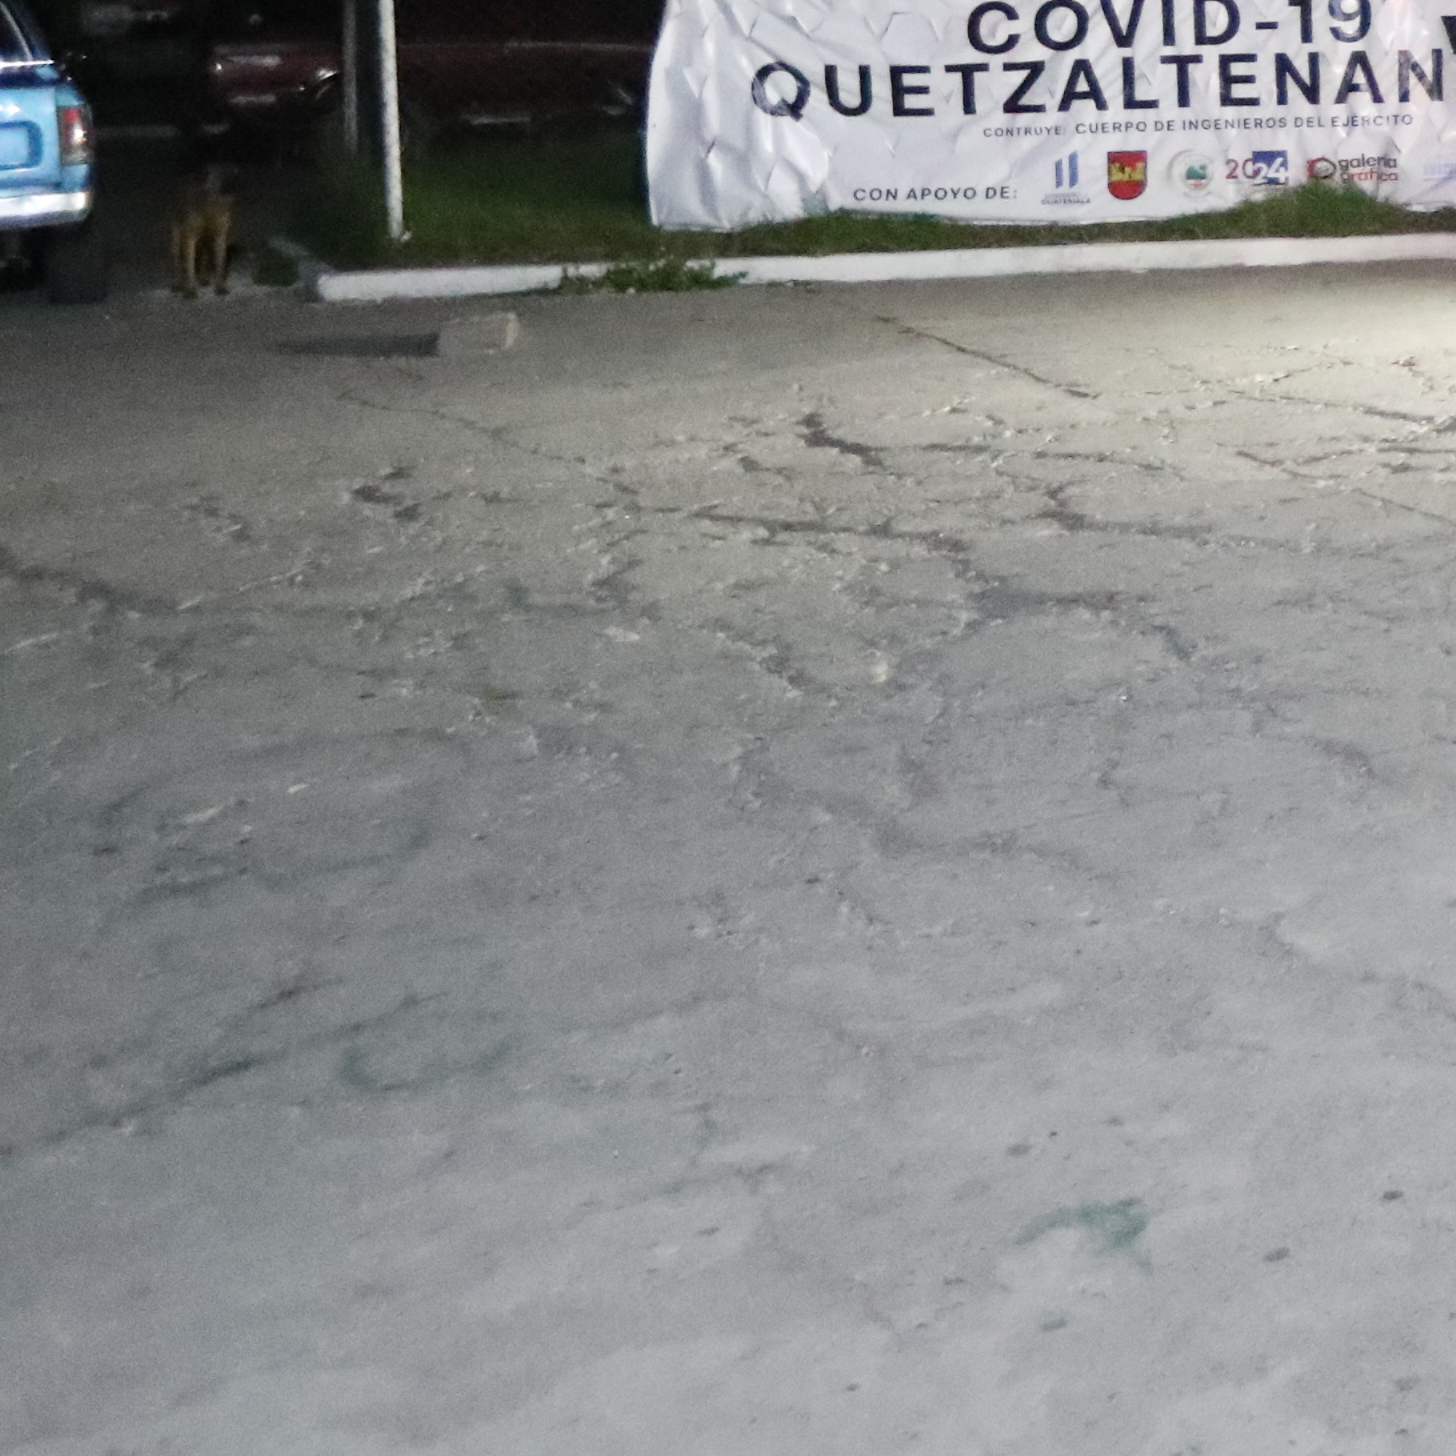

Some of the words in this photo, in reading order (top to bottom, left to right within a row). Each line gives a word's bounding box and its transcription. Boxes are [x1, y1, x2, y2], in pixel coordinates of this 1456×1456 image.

[1075, 121, 1148, 135] CUERPO
[1154, 119, 1175, 132] DE
[1182, 116, 1288, 131] INGENIEROS
[1294, 115, 1325, 129] DEL
[853, 187, 899, 202] CON
[906, 186, 978, 201] APOYO
[985, 185, 1018, 200] DE:
